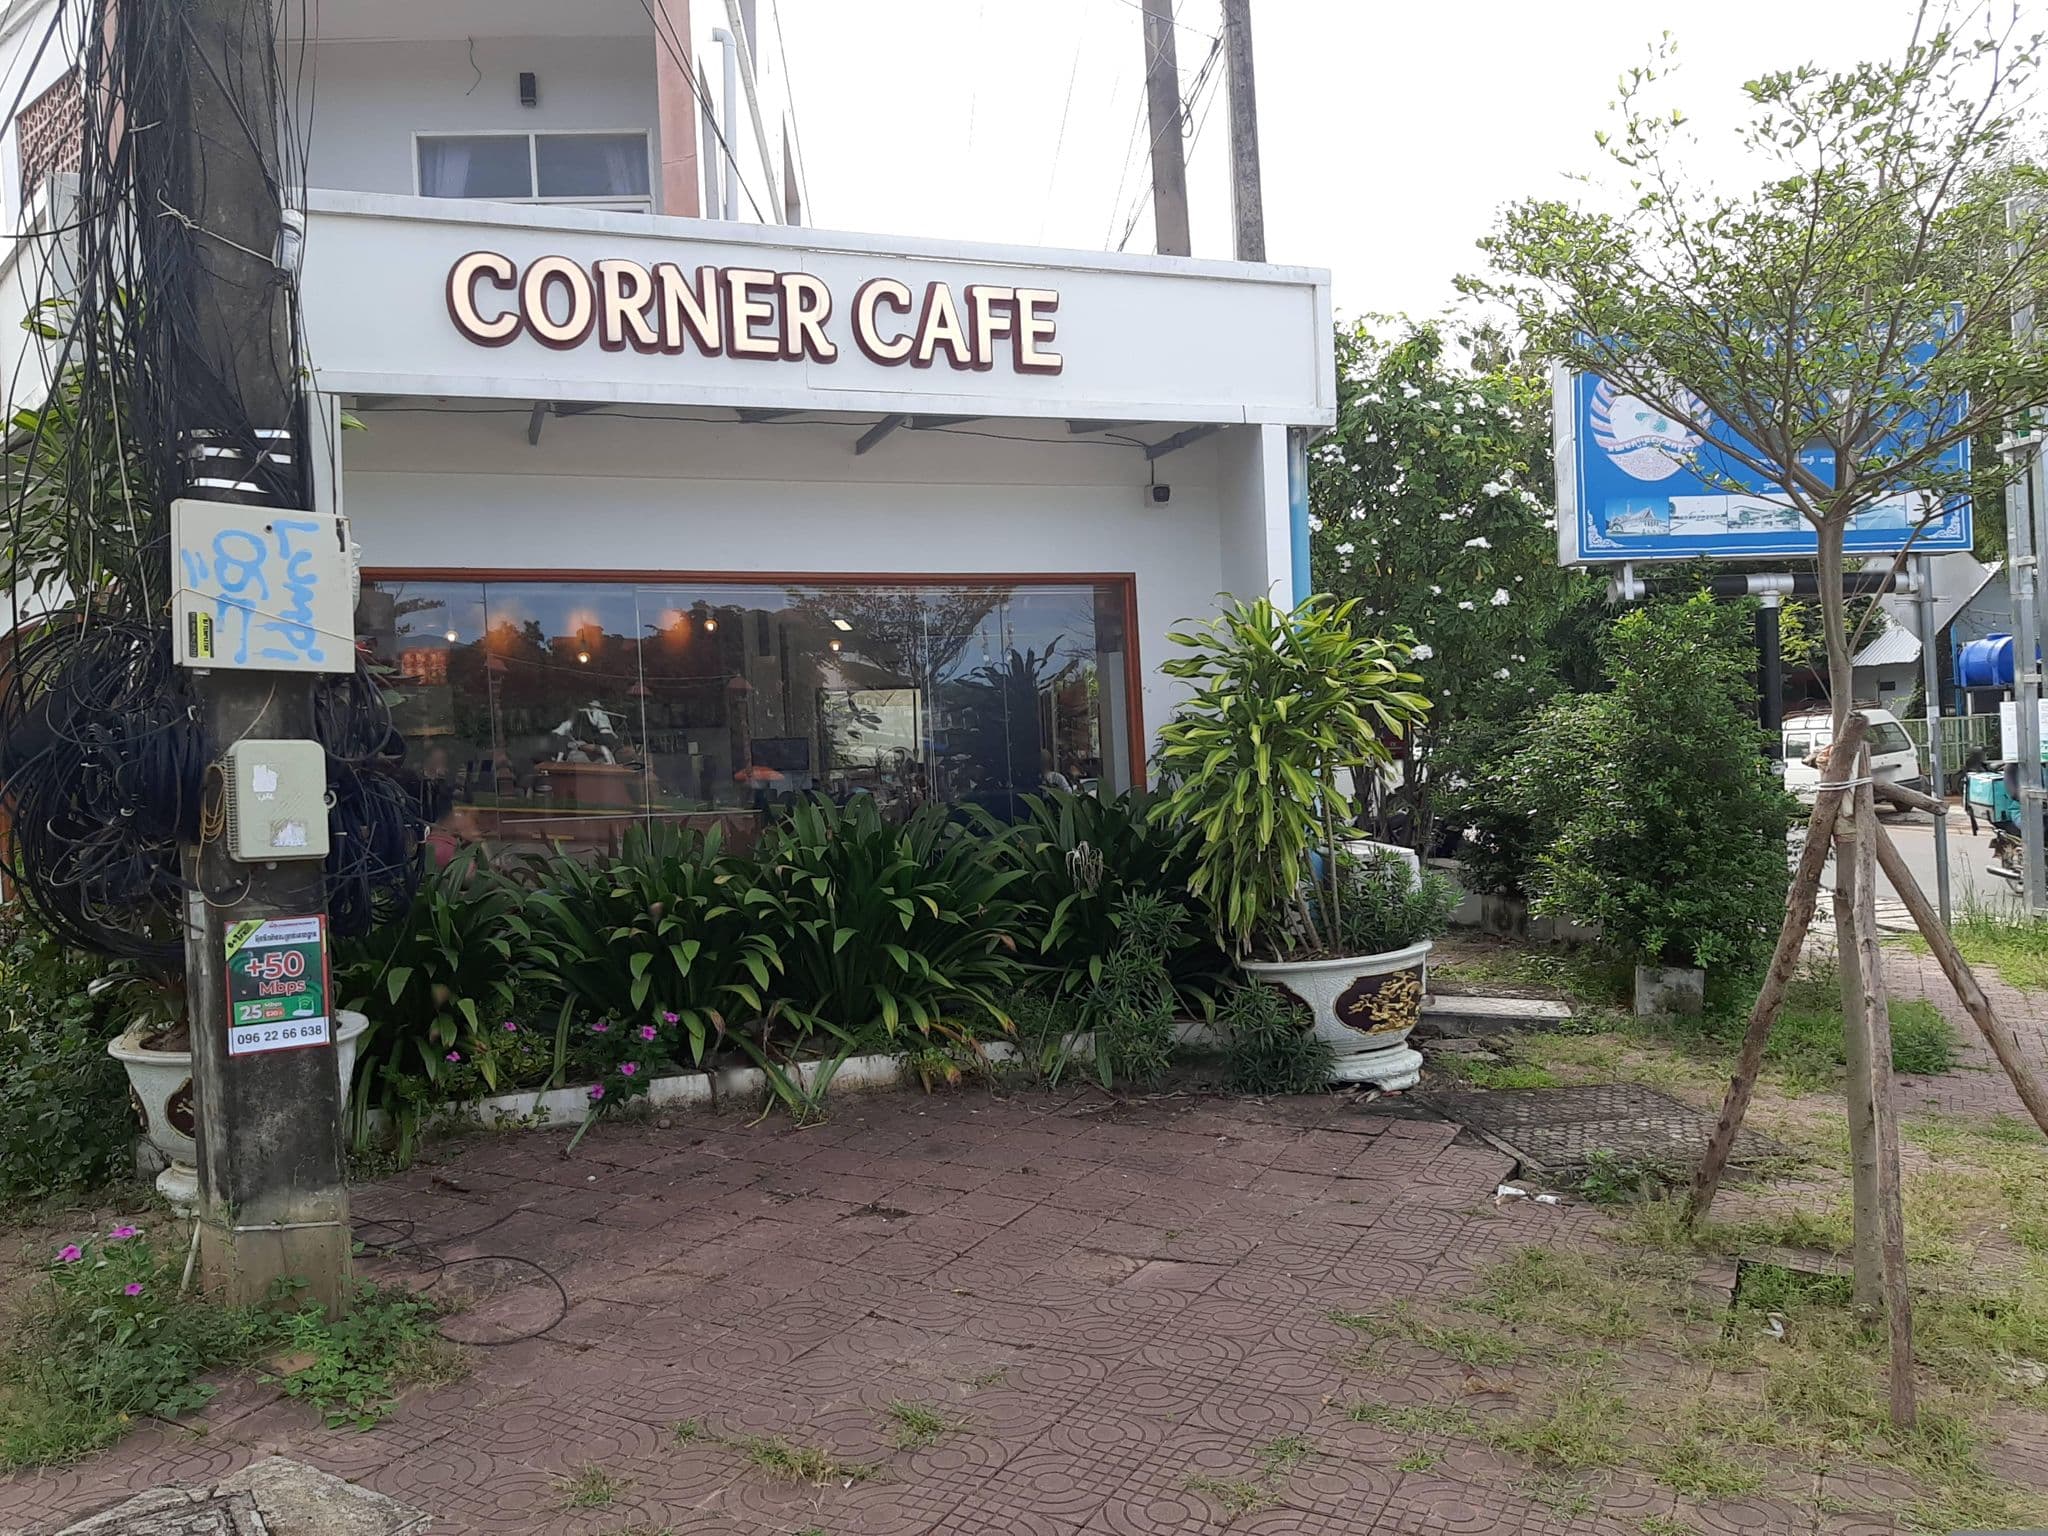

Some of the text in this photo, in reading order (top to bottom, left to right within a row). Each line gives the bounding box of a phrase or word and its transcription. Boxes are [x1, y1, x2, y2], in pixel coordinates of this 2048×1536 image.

[446, 250, 1064, 375] CORNER CAFE
[244, 950, 305, 979] +50
[259, 980, 306, 996] Mbps
[239, 1003, 263, 1021] 25
[237, 1024, 322, 1045] 096 22 66 638
